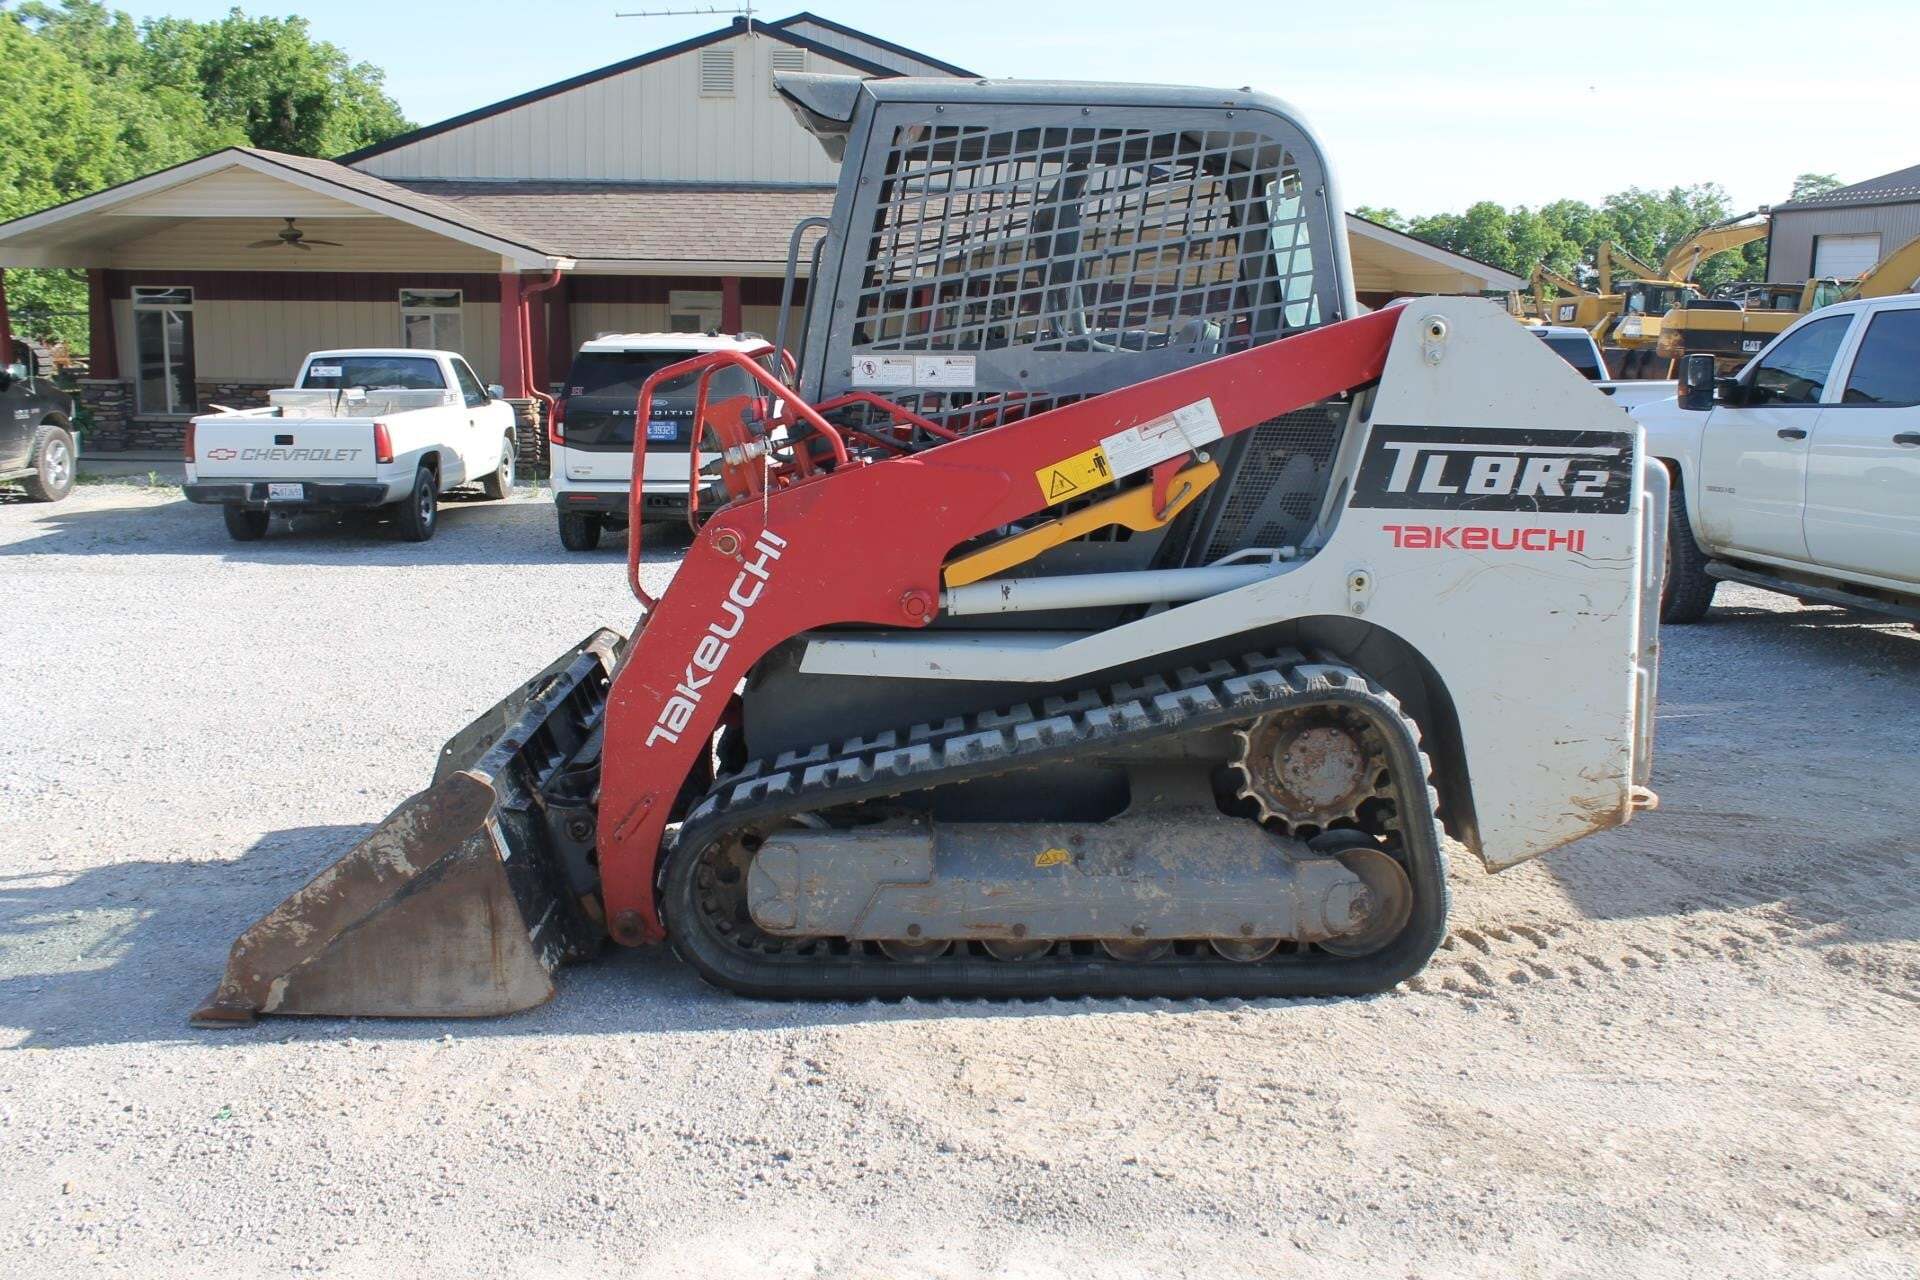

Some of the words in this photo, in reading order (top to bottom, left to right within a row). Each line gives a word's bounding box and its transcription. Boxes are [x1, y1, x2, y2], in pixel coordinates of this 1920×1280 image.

[1559, 306, 1575, 321] CAT
[240, 448, 363, 461] CHEVROLET
[1384, 442, 1621, 497] TL8R2
